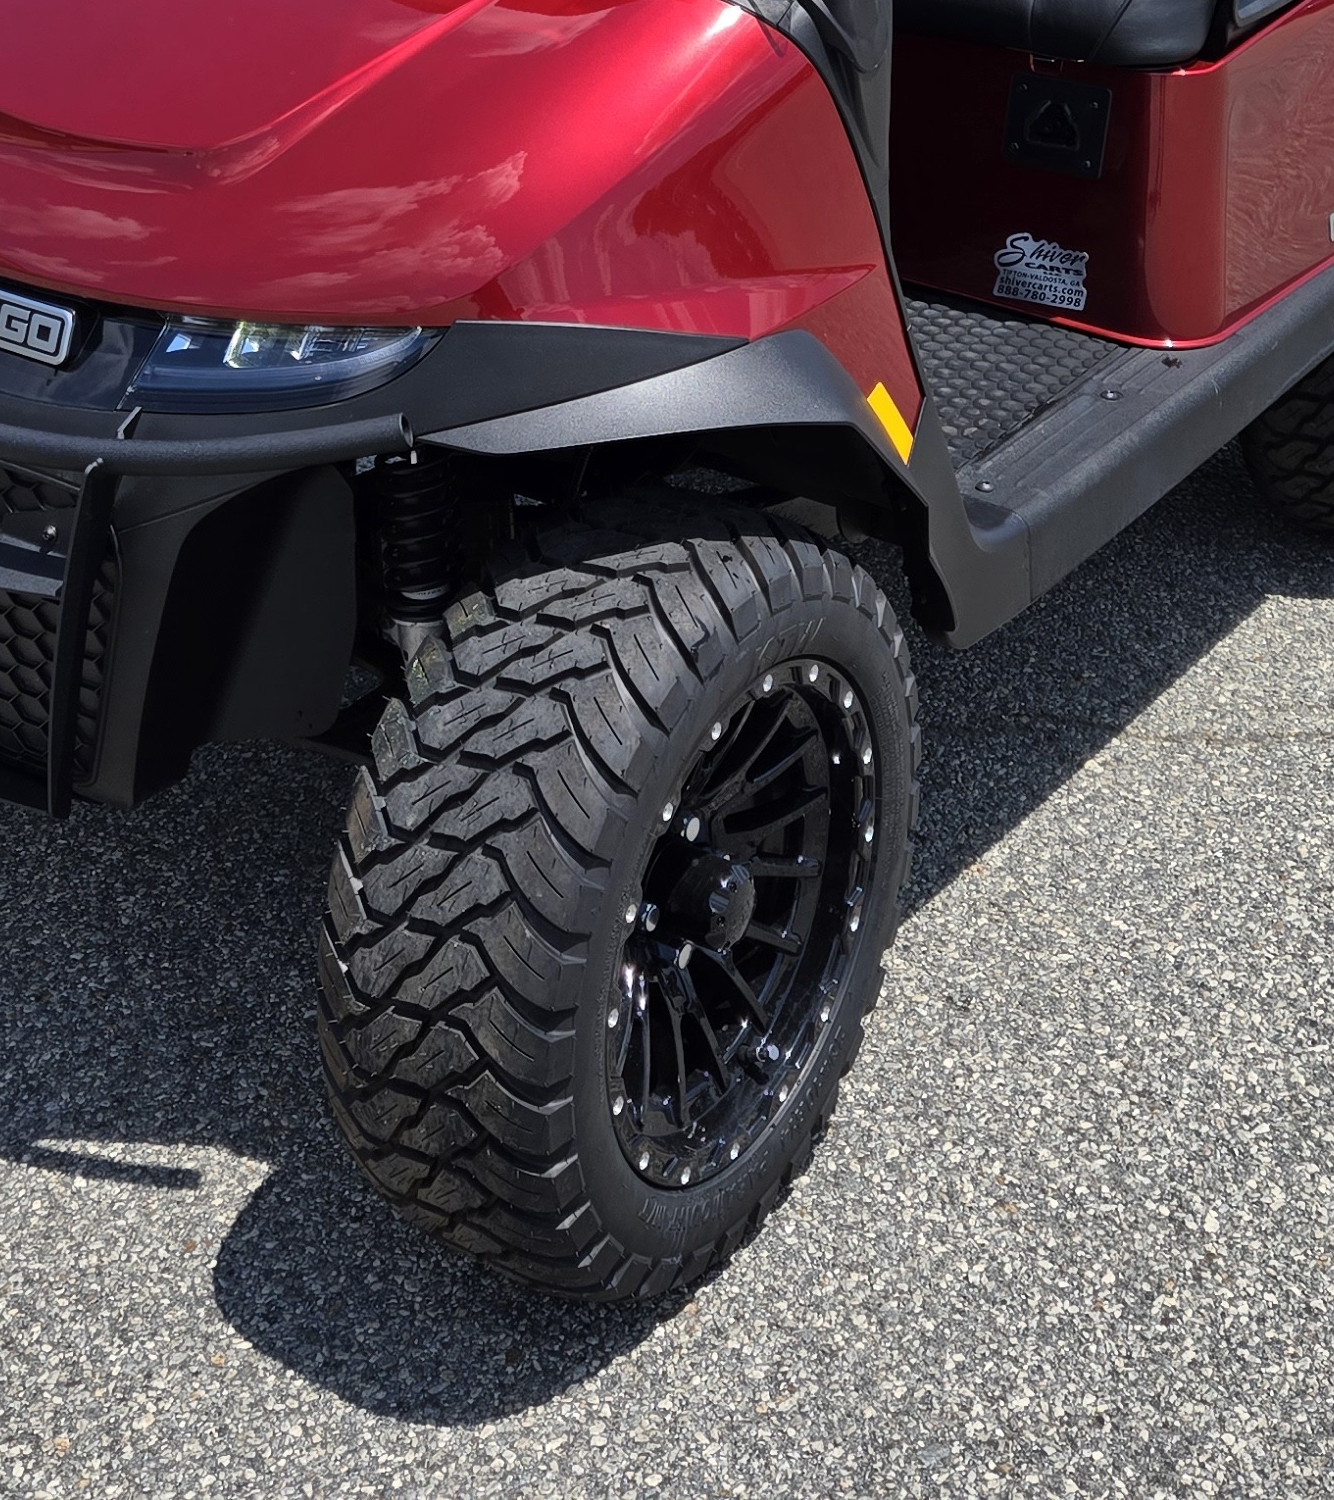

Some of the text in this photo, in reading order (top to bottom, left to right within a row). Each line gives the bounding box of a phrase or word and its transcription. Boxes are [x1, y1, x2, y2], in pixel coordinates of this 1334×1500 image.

[997, 235, 1086, 267] Shiver
[1024, 262, 1084, 277] CARTS
[997, 284, 1082, 308] 888-780-2998
[999, 275, 1084, 298] shivercarts.com
